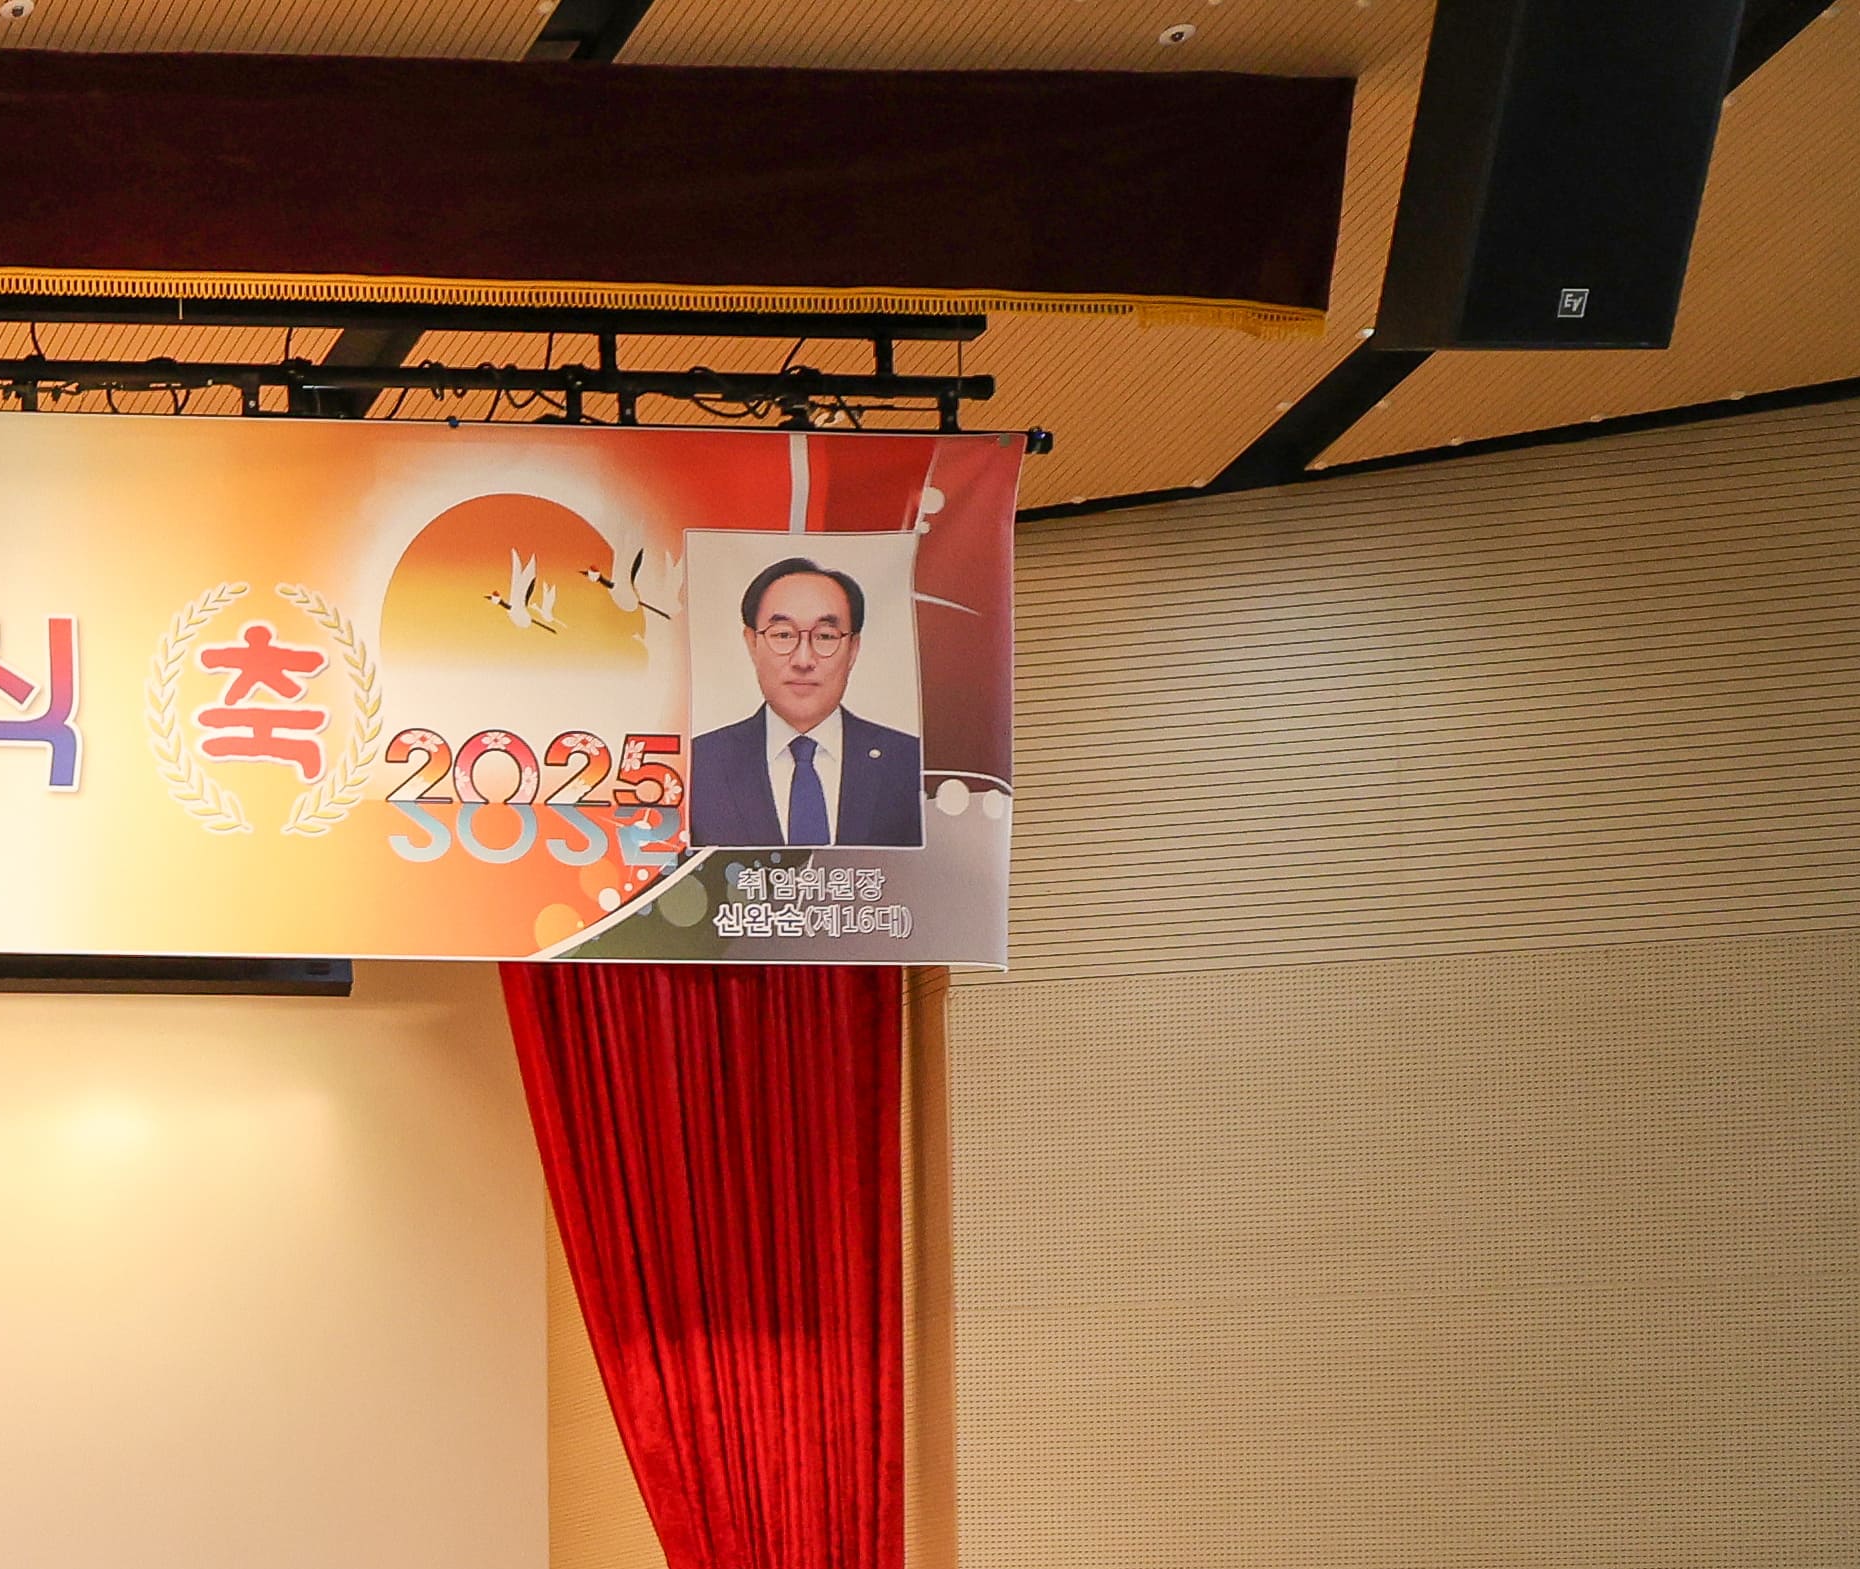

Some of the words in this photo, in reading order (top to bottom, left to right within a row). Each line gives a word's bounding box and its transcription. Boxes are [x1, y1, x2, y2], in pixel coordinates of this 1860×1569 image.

[198, 625, 330, 785] 축
[384, 727, 684, 808] 2025
[737, 867, 886, 902] 취임위원장
[713, 902, 915, 939] 신완순(제16대)
